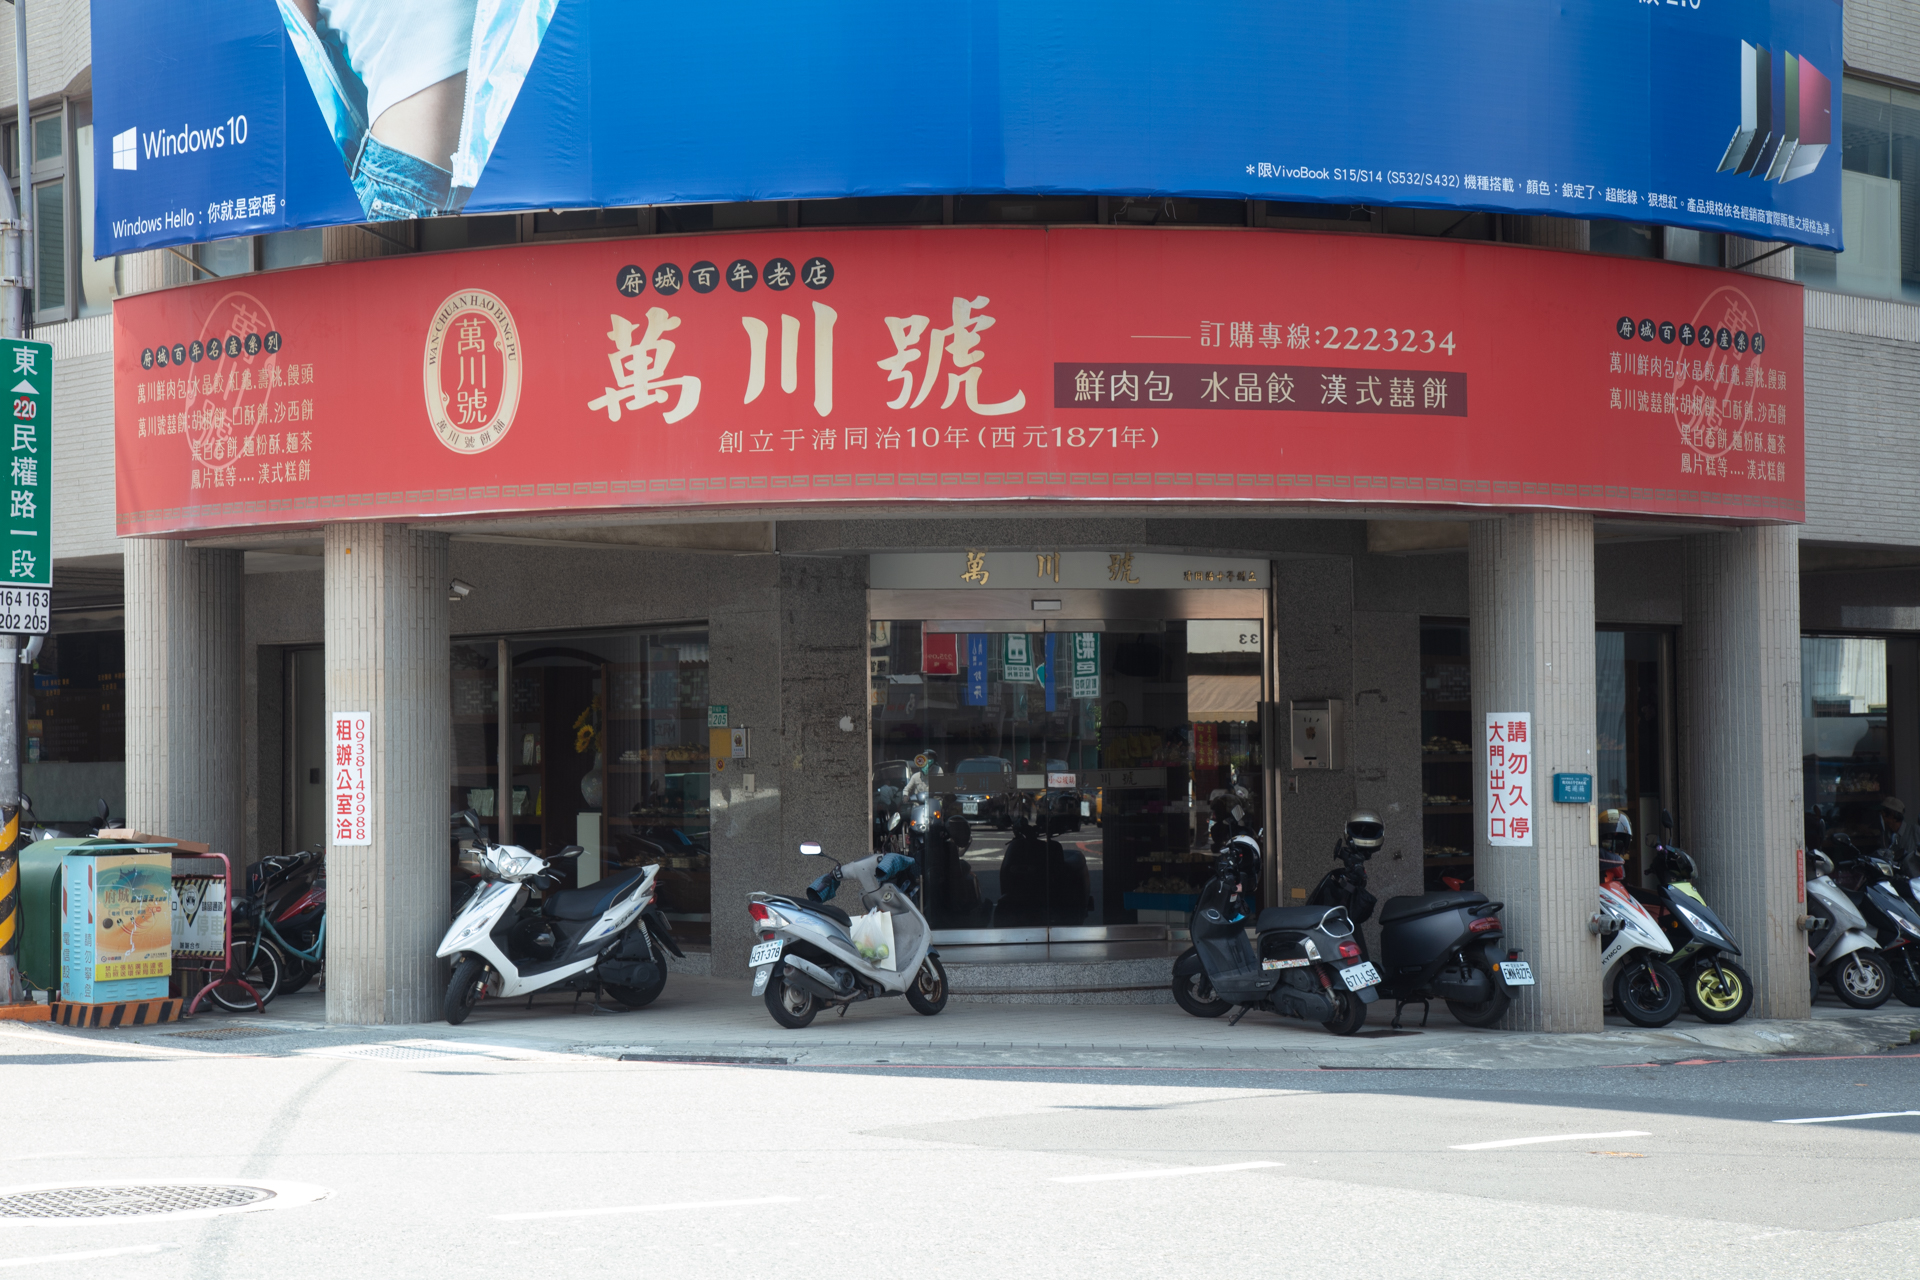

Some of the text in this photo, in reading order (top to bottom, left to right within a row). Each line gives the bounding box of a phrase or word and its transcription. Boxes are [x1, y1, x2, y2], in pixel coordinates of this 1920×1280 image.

[143, 115, 248, 160] Windows 10
[1333, 168, 1383, 183] S15/S14
[1386, 170, 1460, 188] (S532/S432)
[113, 215, 162, 239] Windows
[618, 258, 833, 296] 府城百年老店
[470, 295, 495, 311] HAO
[493, 308, 513, 341] BING
[506, 343, 517, 362] PU
[12, 345, 38, 376] 東
[455, 317, 488, 425] 萬川號
[587, 295, 1026, 424] 萬川號
[1073, 368, 1449, 409] 鮮肉包 水晶餃 漢式囍餅
[13, 399, 37, 420] 220
[9, 424, 38, 579] 民權路一段
[960, 551, 1140, 585] 萬川號
[26, 592, 48, 608] 163
[24, 614, 47, 630] 205
[712, 714, 727, 725] 205
[336, 719, 353, 840] 租辦公室洽
[355, 719, 366, 840] 0938149988
[1489, 720, 1507, 838] 大門出入口
[1507, 720, 1530, 839] 請勿久停
[1601, 944, 1622, 965] KYMCO
[1345, 969, 1379, 988] 671-LSE
